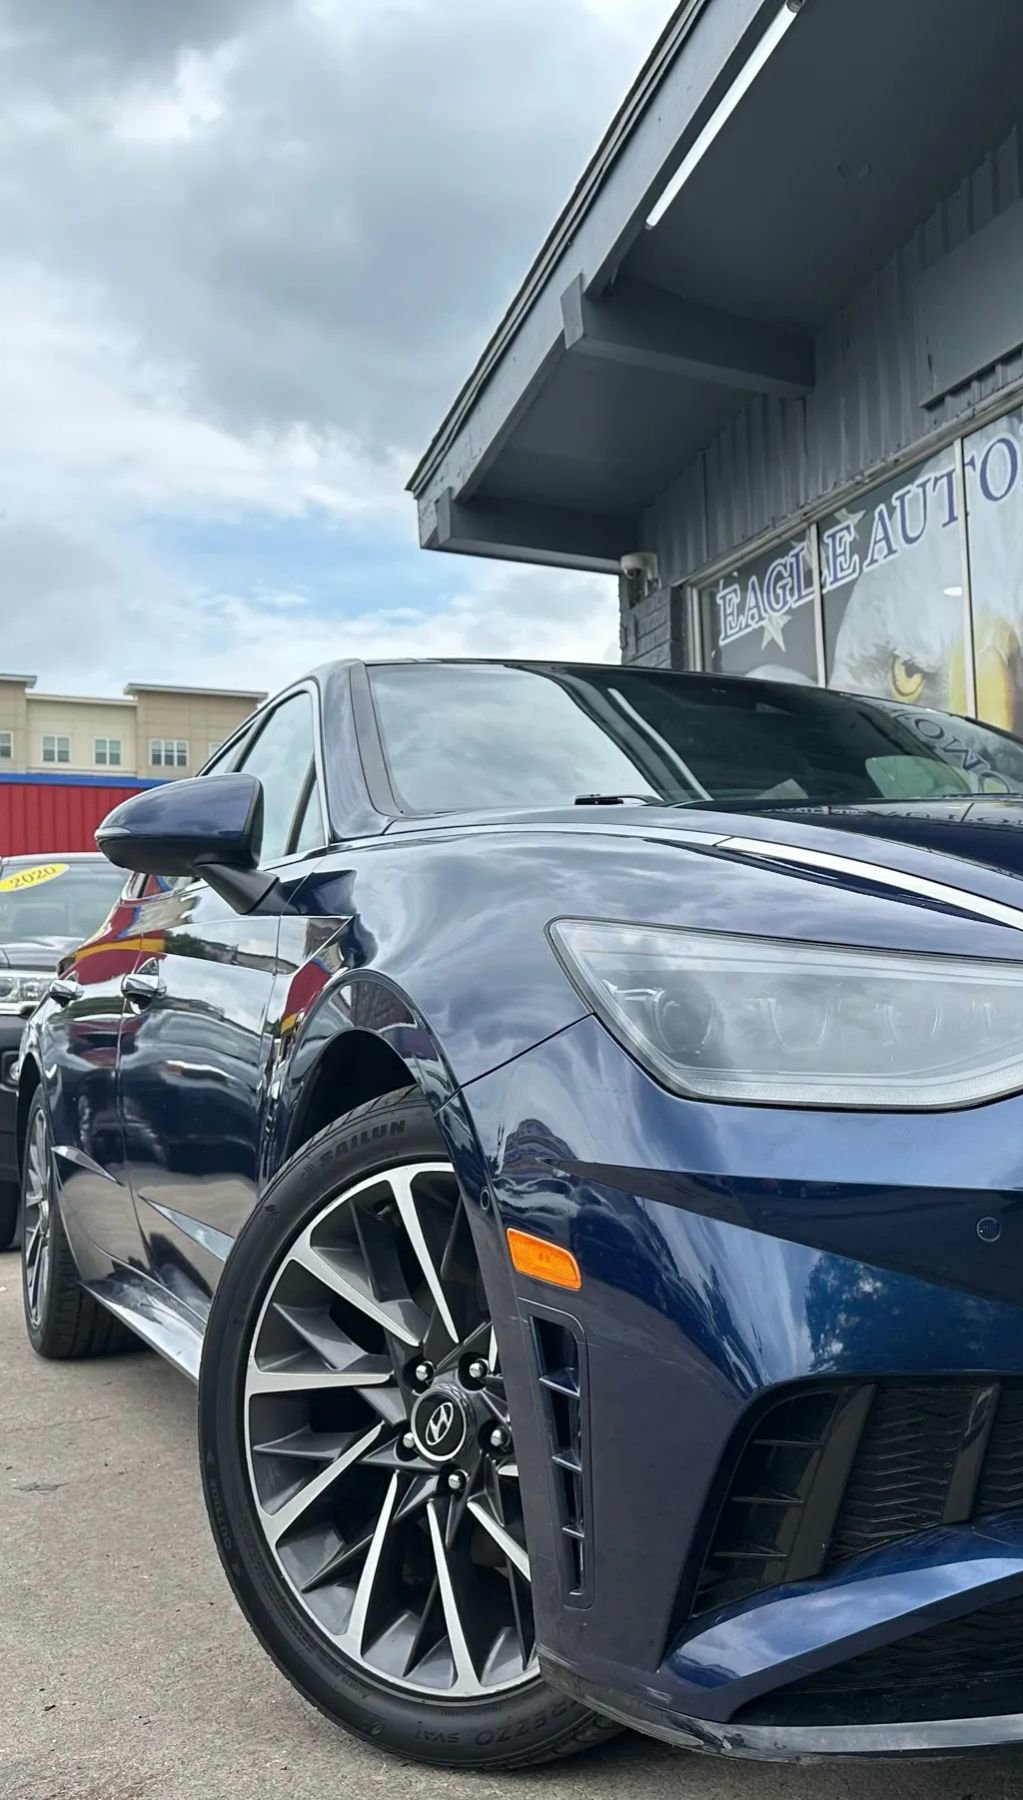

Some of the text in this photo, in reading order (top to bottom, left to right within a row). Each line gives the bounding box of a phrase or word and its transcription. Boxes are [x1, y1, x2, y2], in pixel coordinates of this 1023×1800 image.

[717, 520, 860, 646] EAGLE
[10, 866, 57, 889] 2020
[319, 1119, 407, 1167] SAILUN
